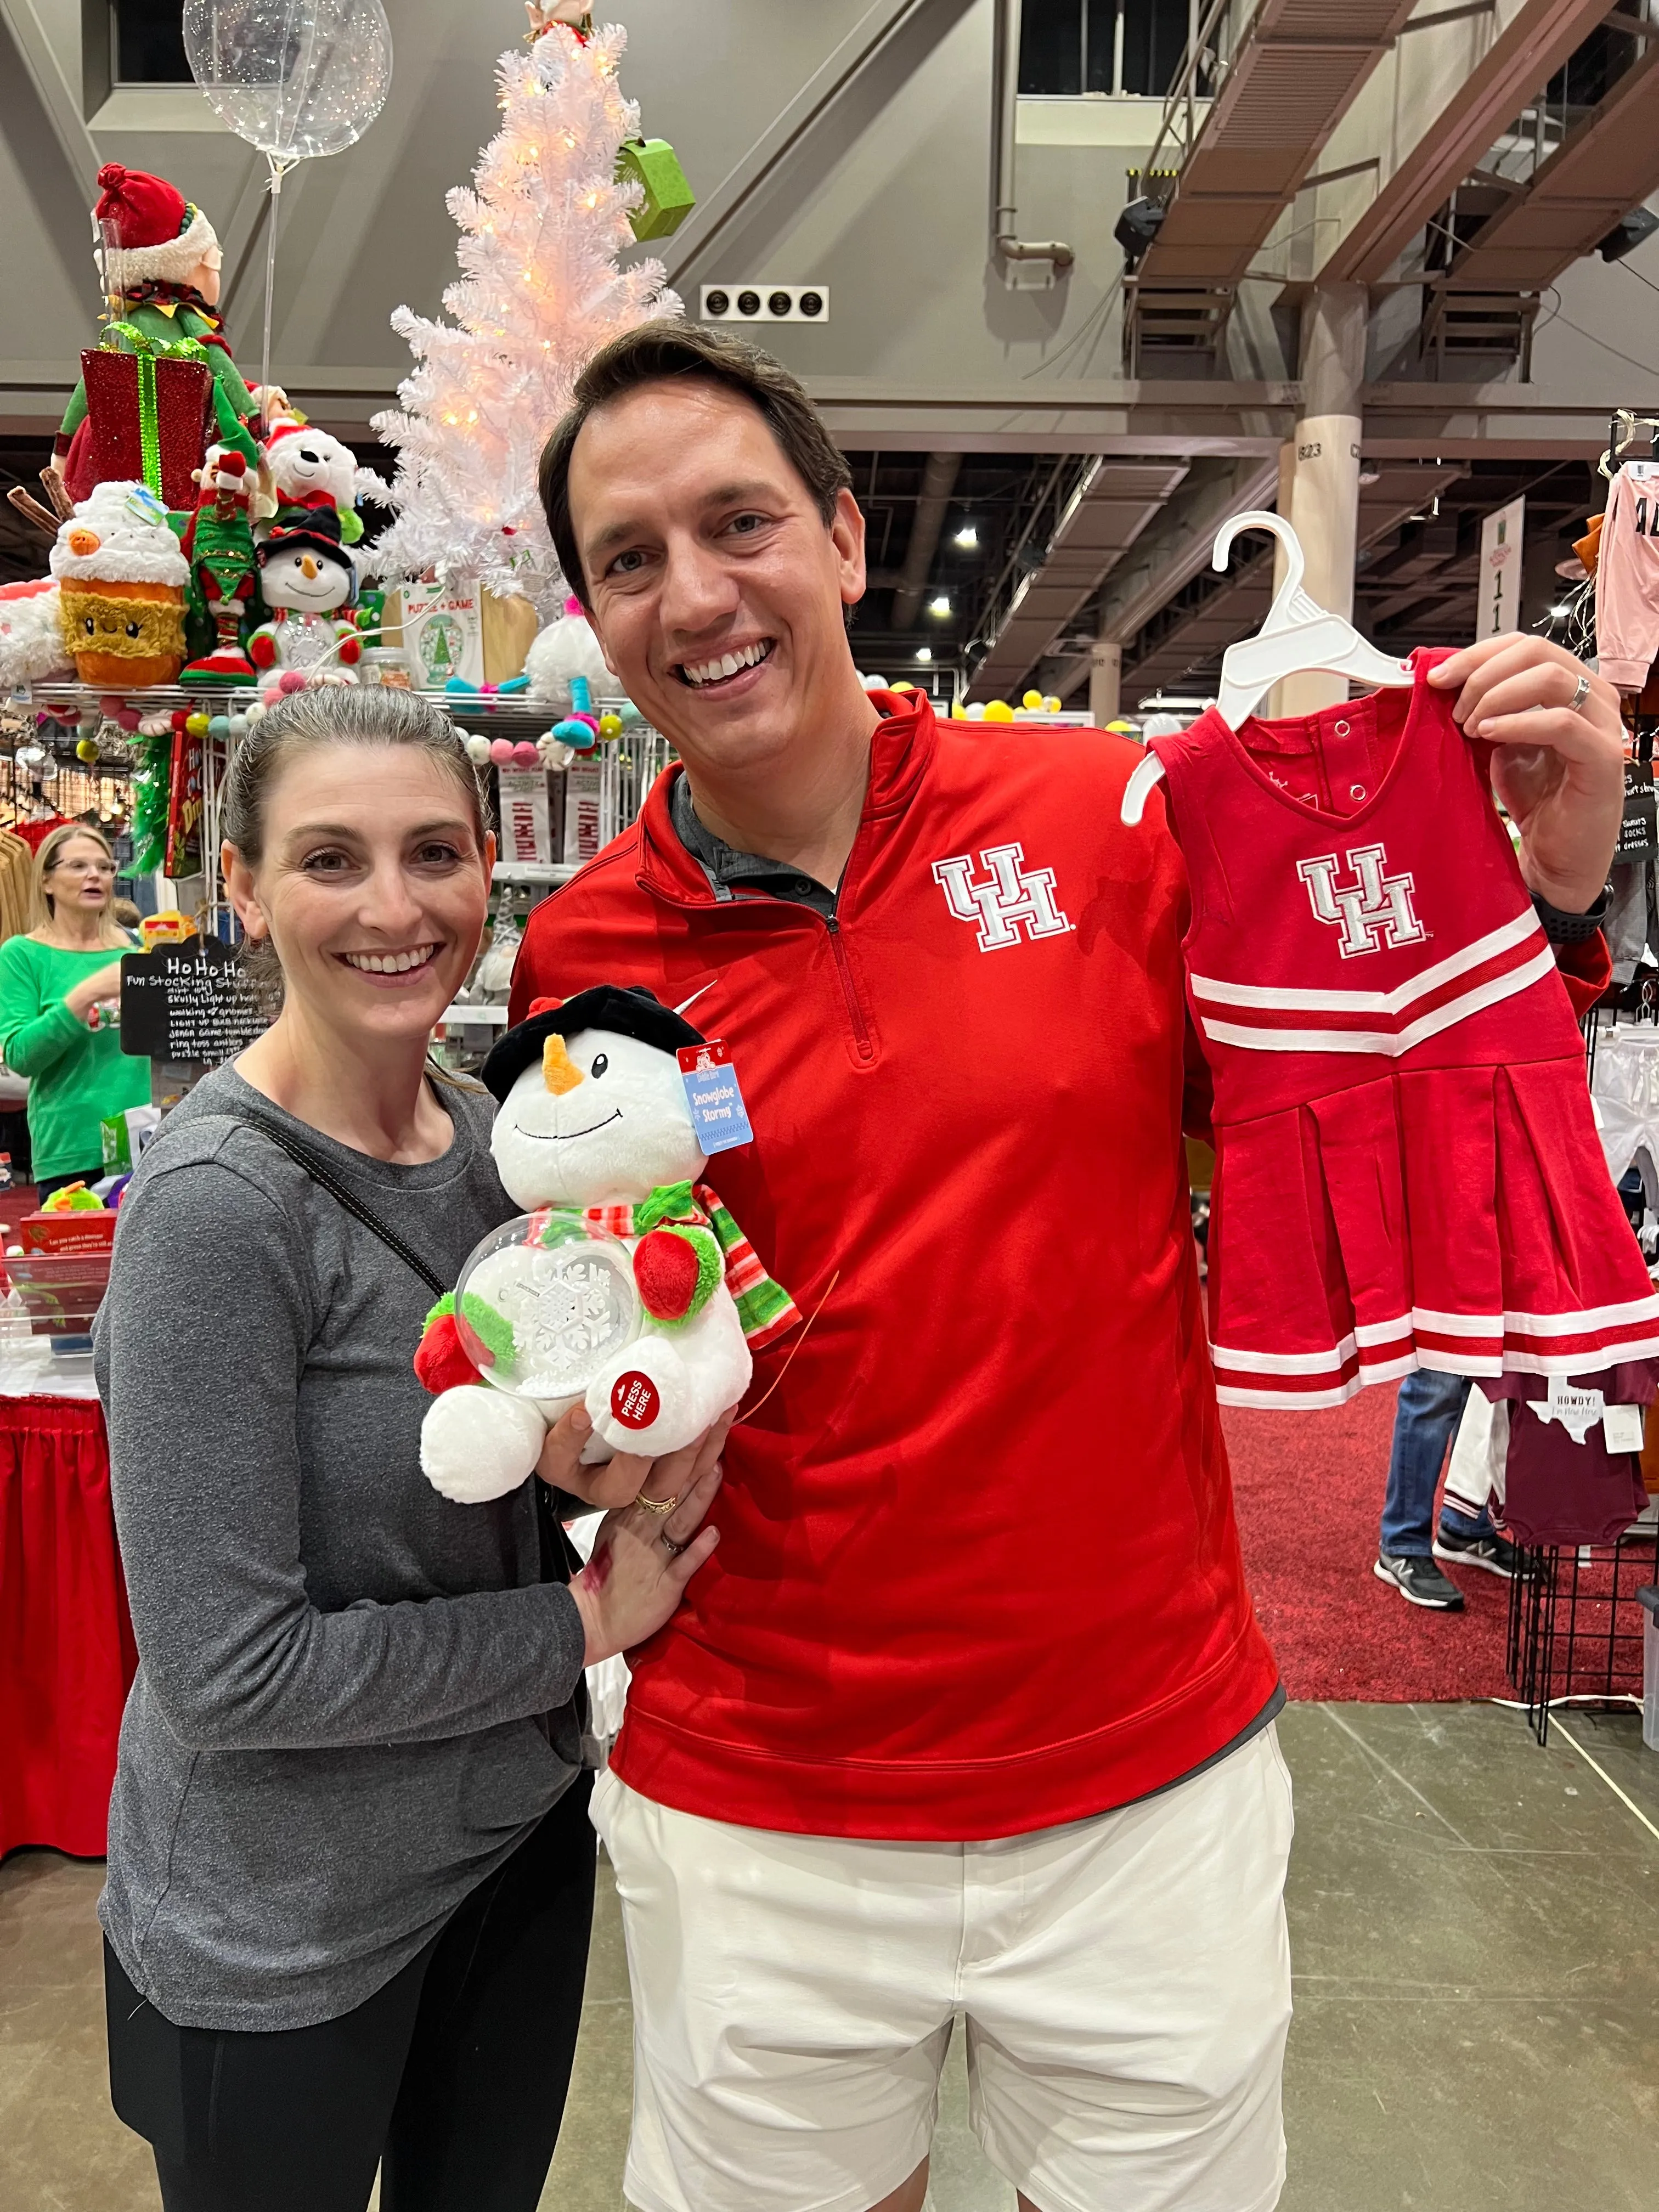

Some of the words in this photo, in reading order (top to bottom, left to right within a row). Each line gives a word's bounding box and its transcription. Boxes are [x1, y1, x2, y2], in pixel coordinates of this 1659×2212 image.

[408, 602, 438, 613] PUZE
[448, 599, 474, 610] GAME
[931, 842, 1071, 953] UH
[1296, 842, 1426, 960] UH
[167, 957, 191, 975] Ho
[195, 957, 219, 977] Ho
[692, 1085, 735, 1107] Snowglobe
[702, 1105, 732, 1122] Stormy
[621, 1380, 642, 1417] PRESS
[632, 1389, 651, 1421] HERE
[1557, 1395, 1596, 1406] HOWDY!
